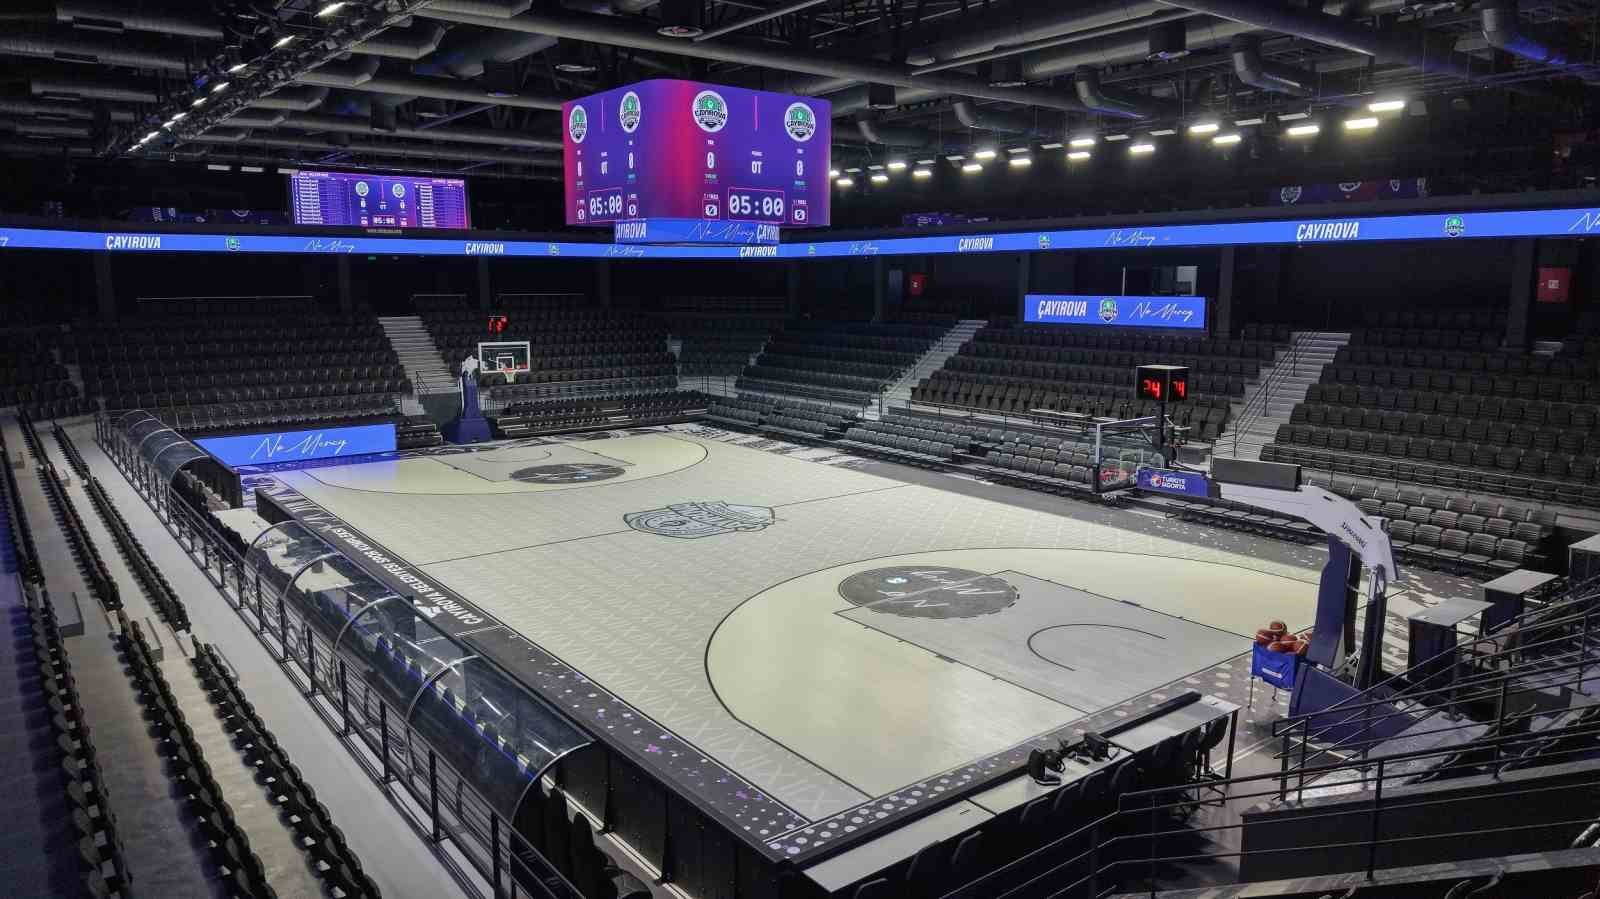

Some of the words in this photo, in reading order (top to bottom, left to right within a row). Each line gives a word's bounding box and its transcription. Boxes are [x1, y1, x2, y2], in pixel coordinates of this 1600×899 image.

[707, 151, 715, 169] 0
[751, 160, 763, 174] OT
[796, 159, 804, 176] 0
[590, 194, 622, 215] 05:00
[705, 204, 718, 216] 0
[729, 194, 784, 216] 05:00
[1038, 300, 1088, 319] ÇAYIROVA
[1129, 302, 1152, 319] No
[251, 435, 283, 459] No
[283, 433, 347, 455] Mercy
